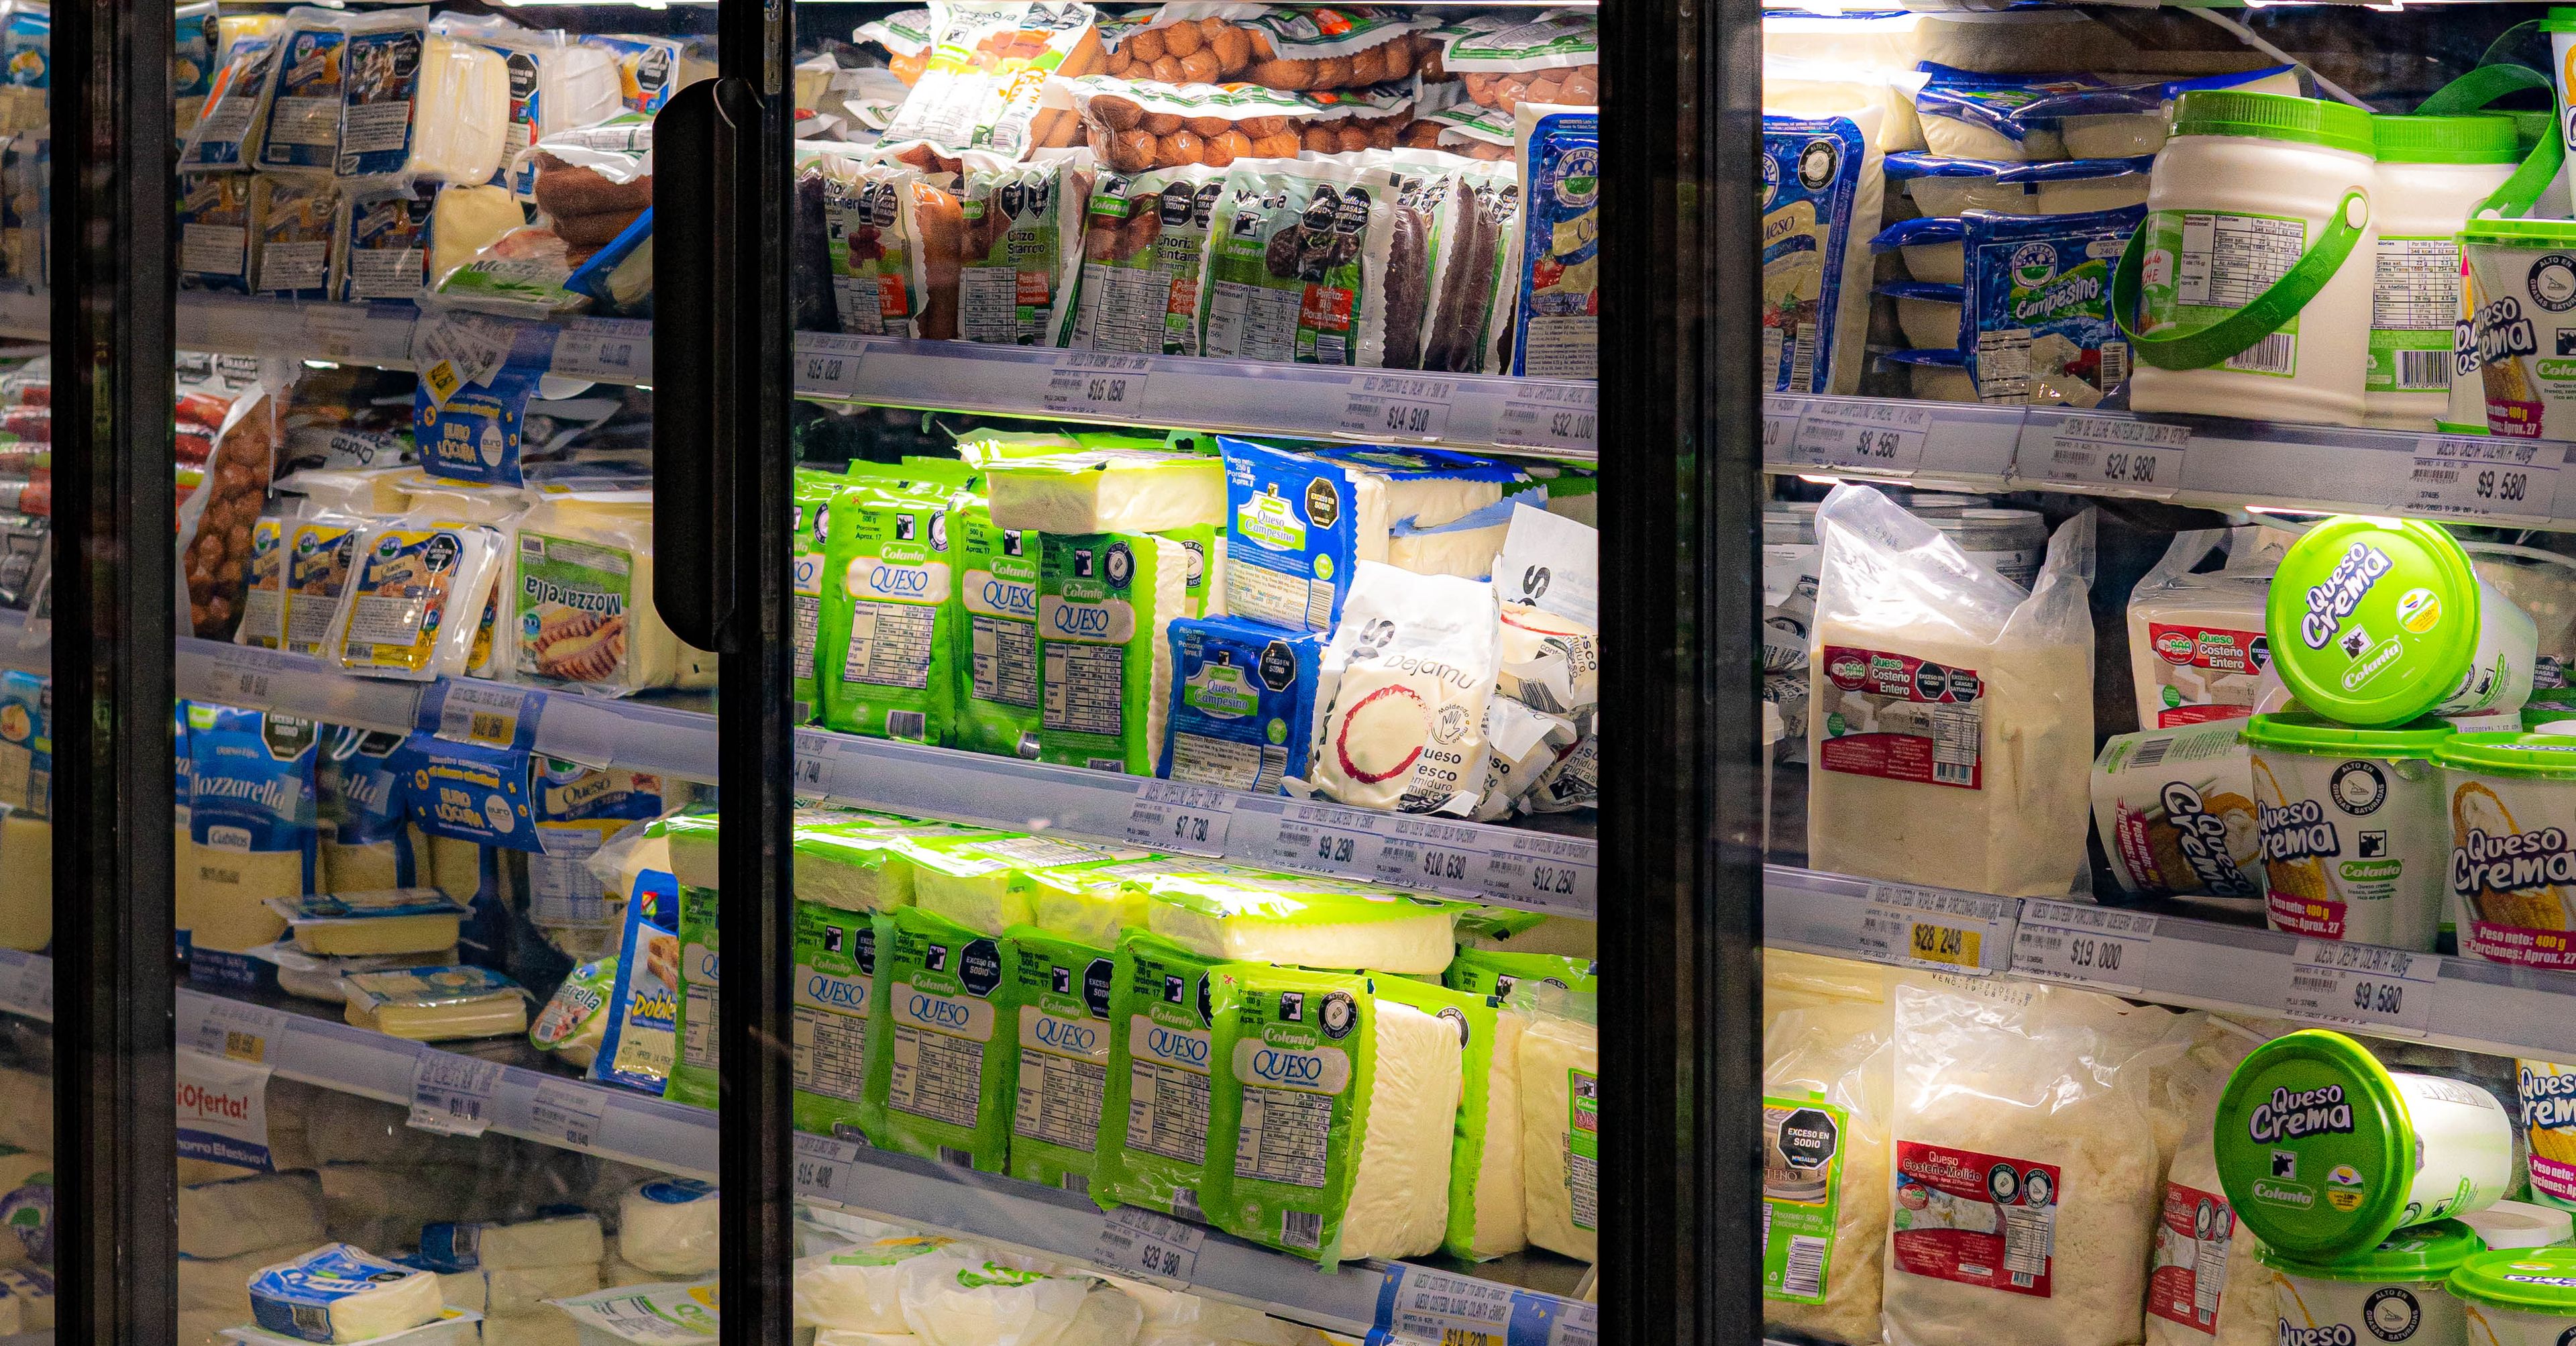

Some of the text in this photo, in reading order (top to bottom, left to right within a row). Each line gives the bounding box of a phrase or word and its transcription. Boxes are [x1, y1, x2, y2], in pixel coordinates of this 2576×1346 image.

[2540, 256, 2574, 268] ALTO EN
[2015, 276, 2099, 319] Campesino
[2530, 278, 2548, 307] GRASAS
[1088, 379, 1126, 402] $16.050
[1387, 406, 1430, 431] $14.910
[1551, 413, 1595, 438] $32.100
[2504, 421, 2537, 435] Aprox. 27
[1857, 430, 1900, 458] $8.560
[2104, 452, 2157, 483] $24.980
[2477, 470, 2527, 501] $9.580
[1314, 501, 1331, 511] SODIO
[1257, 509, 1285, 527] Queso
[1245, 519, 1295, 543] Campesino
[881, 546, 926, 562] Colanta
[965, 544, 983, 553] Aprox.
[870, 566, 928, 593] QUESO
[991, 561, 1034, 579] Colanta
[2306, 542, 2368, 614] Queso
[525, 576, 622, 615] Mozzarella
[1063, 582, 1104, 600] Colanta
[2302, 547, 2393, 650] Crema
[1055, 604, 1109, 634] QUESO
[2198, 631, 2234, 645] Queso
[1265, 656, 1283, 665] EXCESO
[2200, 643, 2245, 658] Costeño
[1269, 665, 1285, 674] SODIO
[1385, 655, 1477, 690] Dejamu
[1871, 655, 1903, 670] Queso
[2209, 656, 2245, 670] Entero
[2345, 644, 2400, 688] Colanta
[1208, 679, 1238, 695] Queso
[1872, 669, 1911, 683] Costeño
[1195, 690, 1248, 710] Campesino
[1880, 682, 1910, 696] Entero
[1203, 737, 1230, 748] Nutricional
[1452, 727, 1468, 744] mano
[1424, 748, 1462, 765] ueso
[2341, 762, 2375, 774] ALTO EN
[562, 778, 612, 805] Queso
[2331, 782, 2385, 815] GRASAS SATURADAS
[1175, 815, 1209, 842] $7.730
[2132, 819, 2144, 840] Peso
[2258, 800, 2322, 836] Queso
[2116, 808, 2135, 859] Porciones:
[2468, 828, 2562, 862] Queso
[1319, 835, 1354, 863] $9.290
[1424, 851, 1466, 880] $10.630
[2340, 862, 2402, 878] Colanta
[2453, 849, 2576, 892] Crema
[1532, 865, 1576, 895] $12.250
[2272, 894, 2329, 921] Peso neto: 400 g
[2299, 914, 2339, 935] Aprox. 27
[2480, 926, 2566, 951] Peso neto: 400 g
[914, 957, 922, 965] 17
[966, 956, 987, 967] EXCESO
[1032, 953, 1051, 963] neto:
[2070, 938, 2123, 971] $19.000
[2470, 939, 2576, 965] Porciones: Aprox. 27
[969, 966, 989, 978] SODIO
[1017, 965, 1051, 980] Porciones:
[1018, 976, 1049, 988] Aprox. 17
[808, 976, 864, 1005] QUESO
[912, 974, 956, 994] Colanta
[1153, 990, 1160, 998] 17
[559, 983, 602, 1011] arella
[633, 991, 676, 1021] Doble
[1040, 996, 1082, 1016] Colanta
[2354, 981, 2403, 1015] $9.580
[909, 995, 970, 1025] QUESO
[1150, 1006, 1193, 1028] Colanta
[1036, 1017, 1095, 1049] QUESO
[1264, 1027, 1316, 1047] Colanta
[1148, 1028, 1208, 1062] QUESO
[1254, 1049, 1322, 1081] QUESO
[2520, 1068, 2576, 1100] Ques
[2273, 1084, 2345, 1116] Queso
[1787, 1127, 1830, 1140] EXCESO EN
[2249, 1102, 2354, 1143] Crema
[1793, 1137, 1821, 1149] SODIO
[1904, 1159, 1982, 1182] Costeño Molido
[1929, 1151, 1959, 1168] Queso
[2533, 1159, 2575, 1182] Peso neto:
[2255, 1182, 2312, 1205] Colanta
[1141, 1245, 1181, 1277] $29.980
[2375, 1289, 2408, 1300] ALTO EN
[2365, 1309, 2420, 1341] GRASAS SATURADAS
